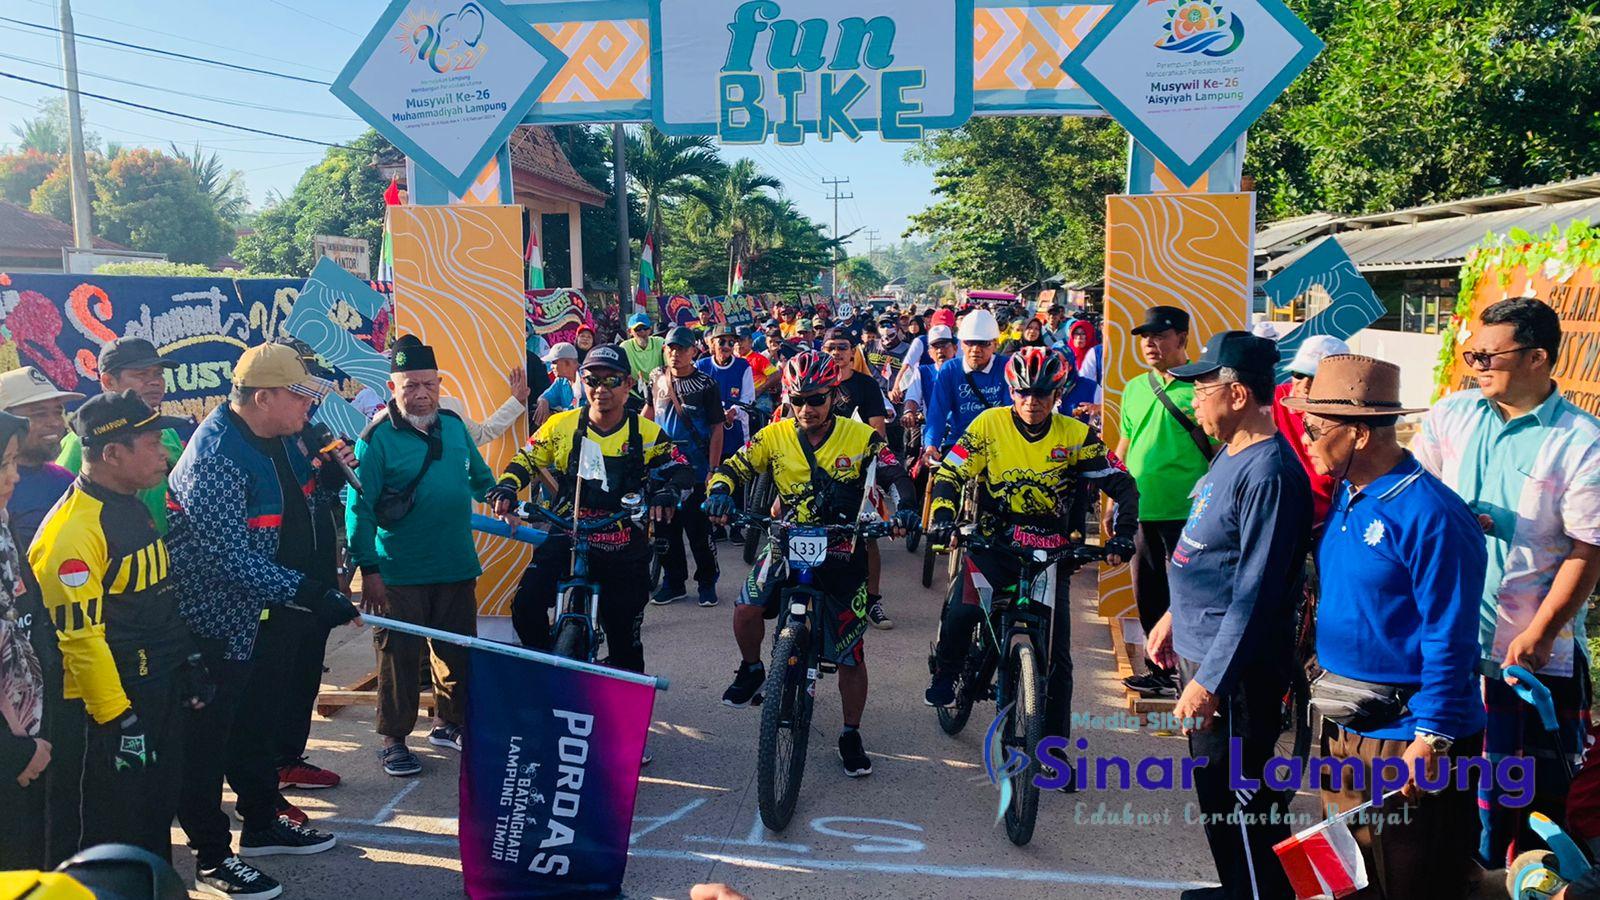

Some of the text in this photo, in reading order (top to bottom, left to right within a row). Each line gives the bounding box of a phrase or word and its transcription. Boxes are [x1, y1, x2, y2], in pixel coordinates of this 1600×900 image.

[720, 0, 896, 72] fun
[406, 88, 490, 109] Musywil Ke-26
[717, 66, 926, 145] BIKE
[1150, 77, 1239, 93] Musywil Ke-26
[1195, 91, 1244, 102] Lampung
[392, 106, 463, 122] Muhammadiyah
[465, 101, 507, 113] Lampung
[793, 541, 823, 556] 1331
[491, 736, 523, 861] LAMPUNG TIMUR
[528, 708, 594, 876] PORDAS
[505, 778, 531, 864] BATANGHARI
